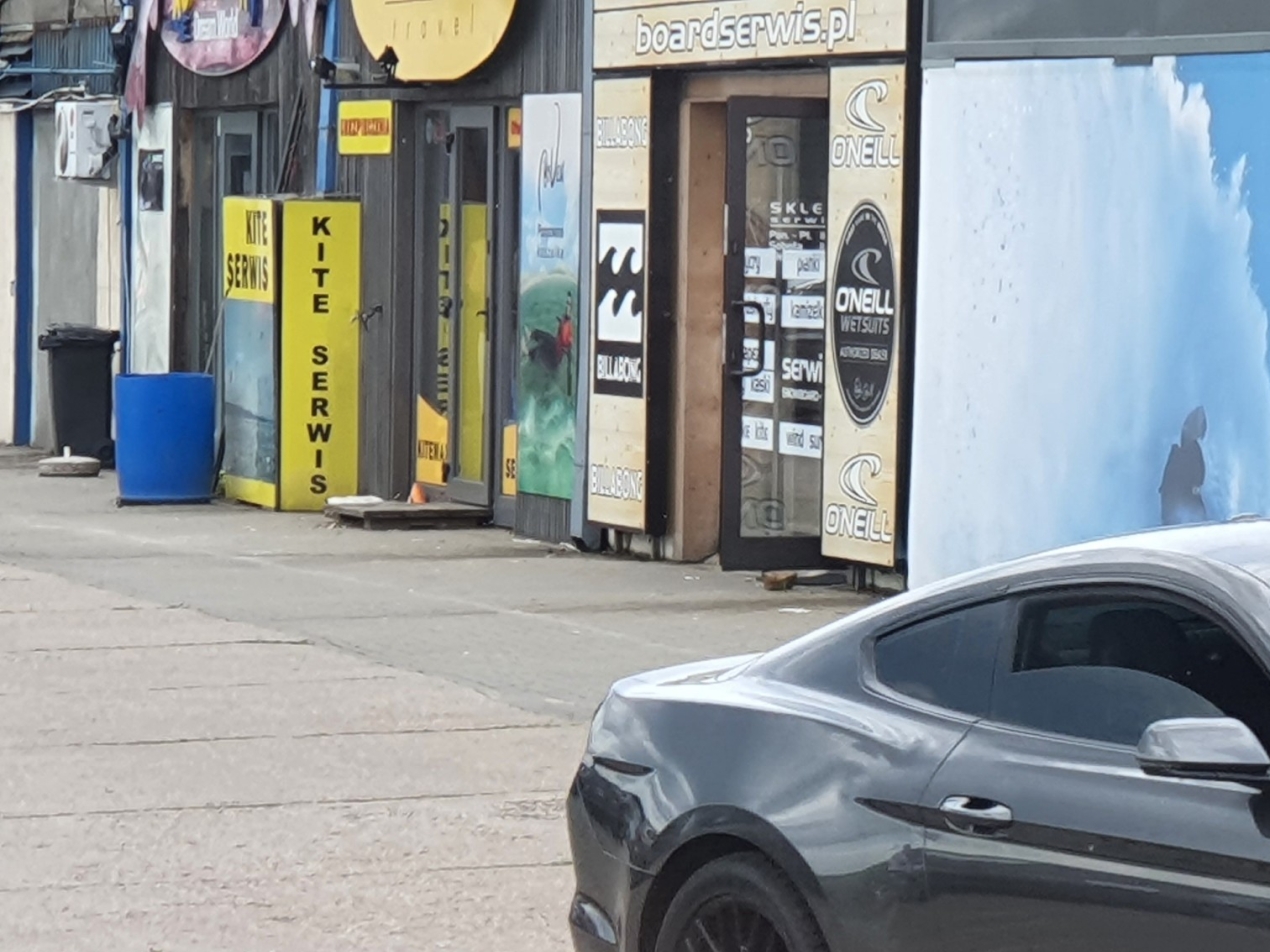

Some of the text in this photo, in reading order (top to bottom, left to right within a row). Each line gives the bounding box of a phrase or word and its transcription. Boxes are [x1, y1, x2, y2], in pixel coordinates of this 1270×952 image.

[635, 0, 856, 55] boardserwis.pl
[596, 116, 648, 149] BILLABONG
[769, 201, 823, 215] SKLE
[246, 210, 268, 246] KITE
[227, 252, 269, 292] SERWIS
[840, 315, 890, 335] WETSUITS
[307, 216, 332, 495] KITE SERWIS
[596, 353, 642, 384] BILLABONG
[782, 353, 823, 383] serwi
[590, 463, 643, 502] BILLABONG
